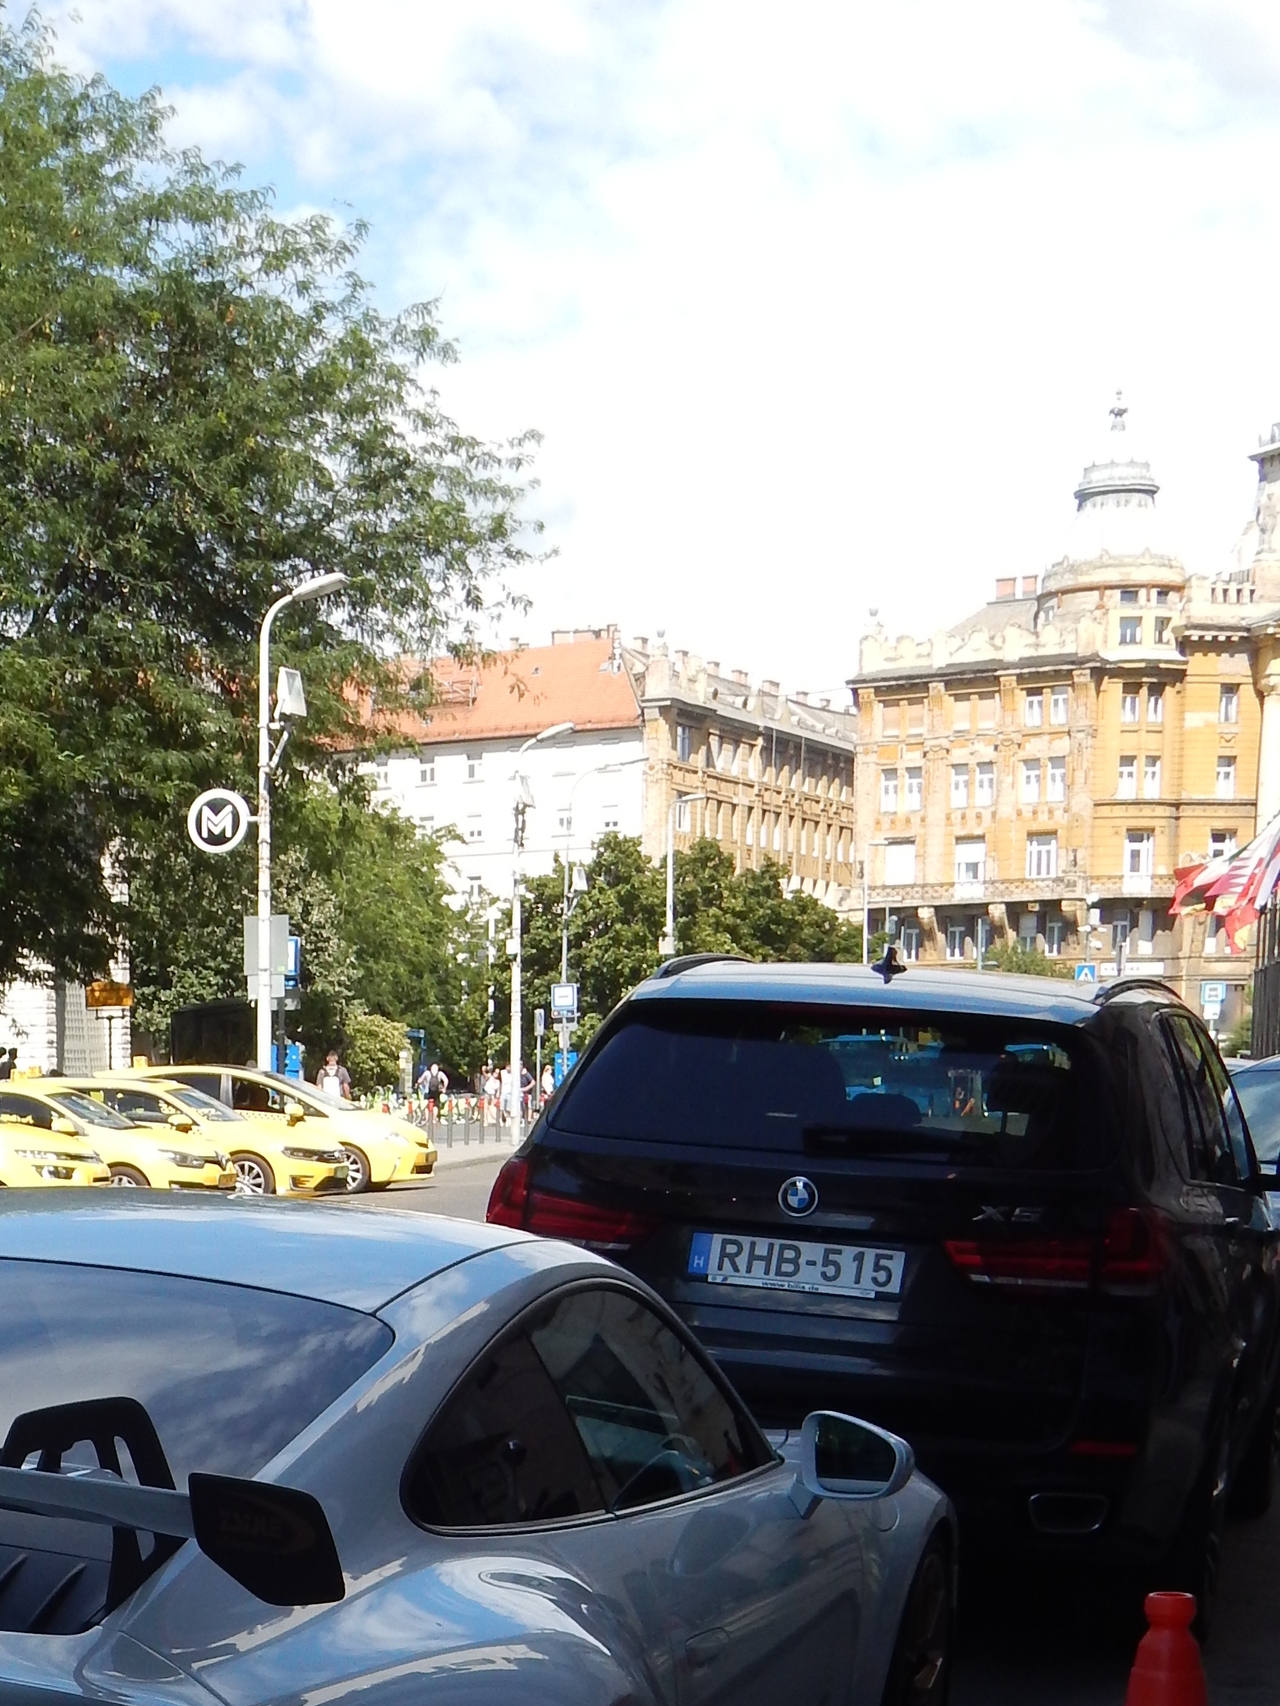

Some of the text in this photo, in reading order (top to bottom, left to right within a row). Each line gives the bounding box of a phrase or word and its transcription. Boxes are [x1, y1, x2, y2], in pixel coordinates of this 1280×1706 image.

[201, 804, 233, 838] M
[972, 1205, 1044, 1222] X5
[694, 1255, 704, 1268] H
[717, 1238, 895, 1288] RHB-515
